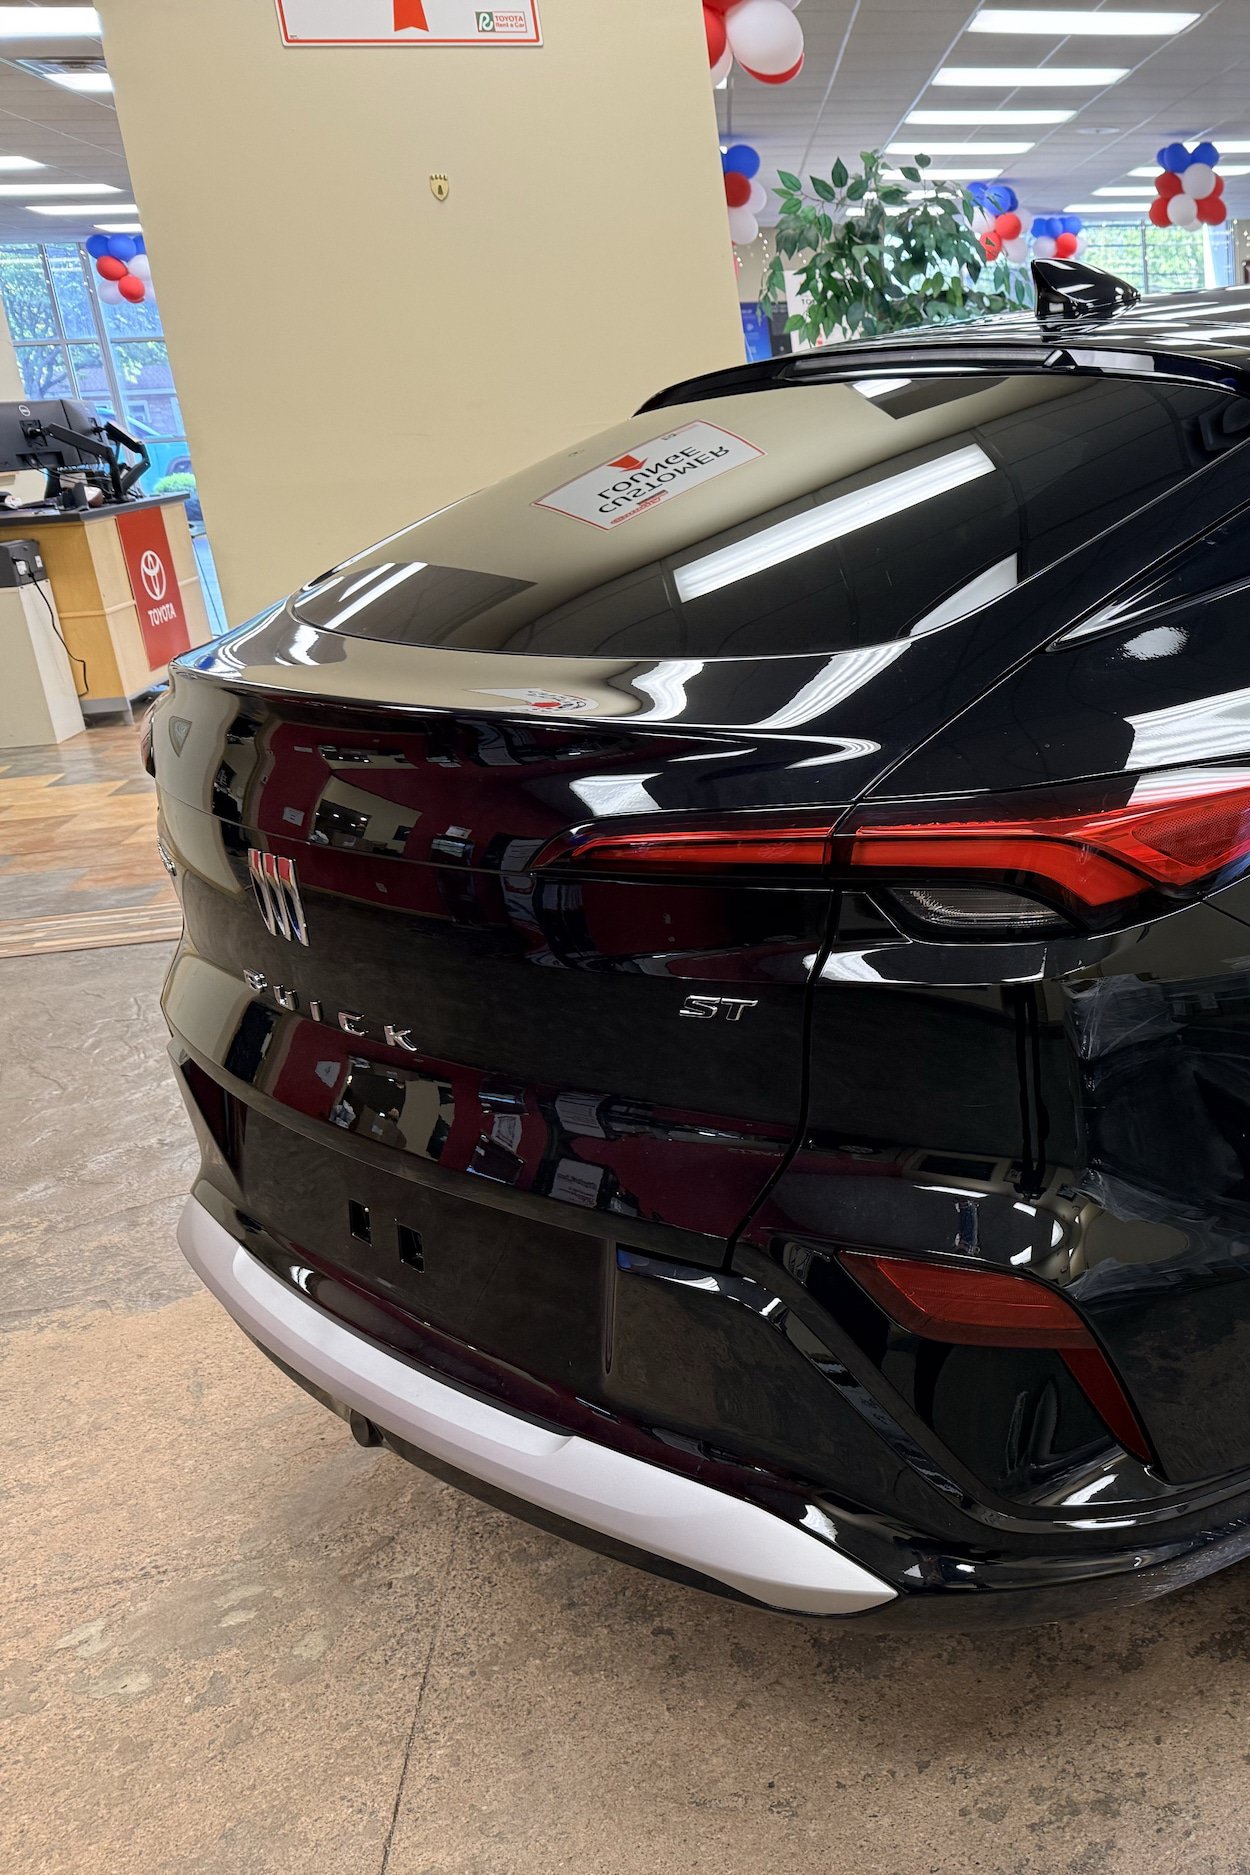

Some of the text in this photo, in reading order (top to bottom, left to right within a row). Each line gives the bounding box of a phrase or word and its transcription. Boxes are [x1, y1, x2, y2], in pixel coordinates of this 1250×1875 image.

[147, 602, 177, 627] TOYOTA
[243, 969, 418, 1052] BUICK
[679, 994, 760, 1021] ST
